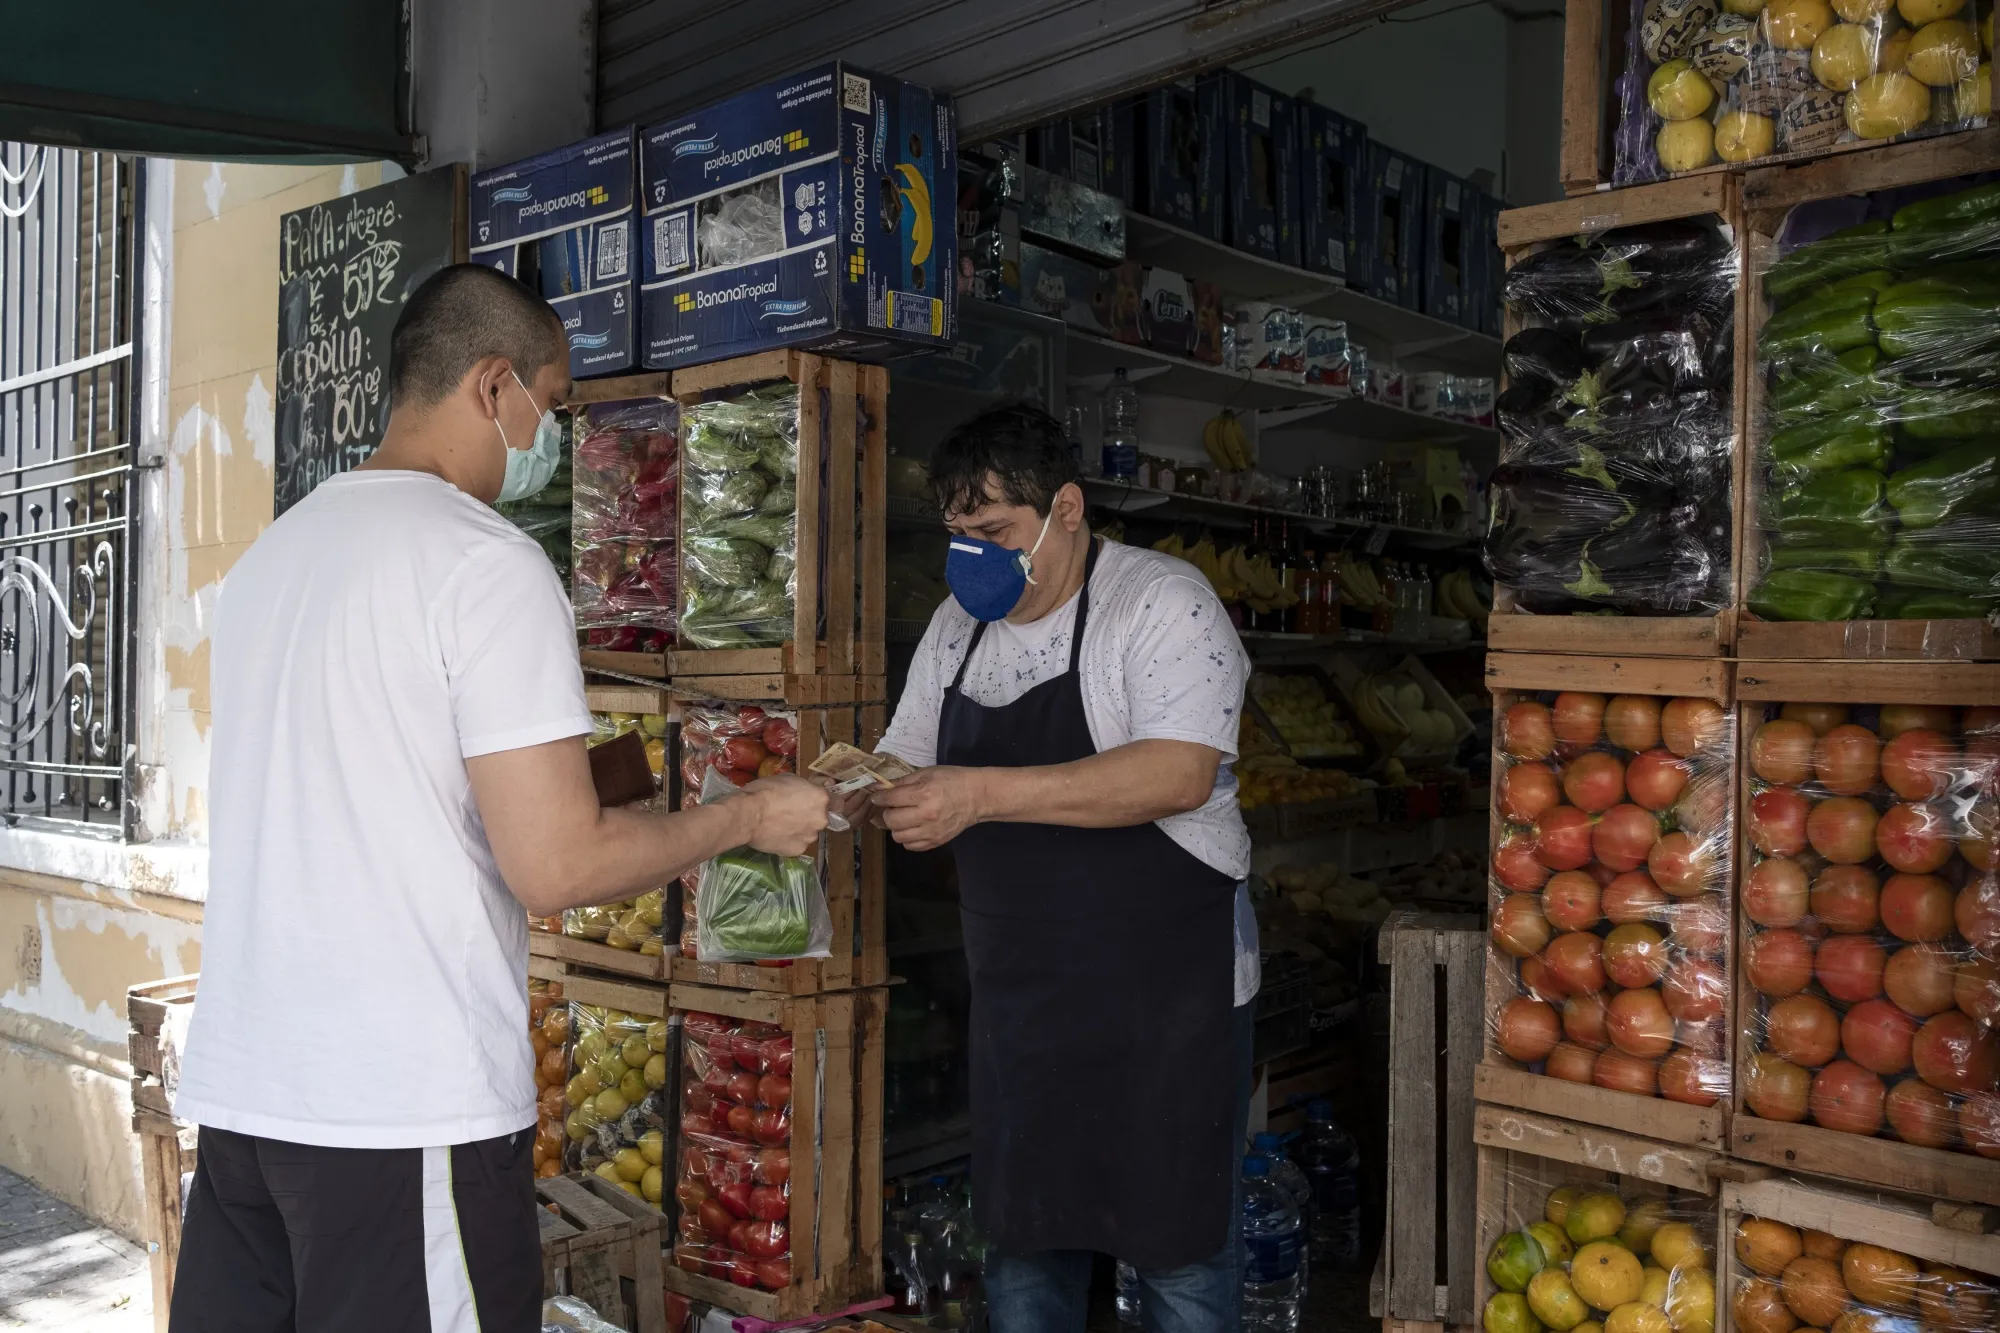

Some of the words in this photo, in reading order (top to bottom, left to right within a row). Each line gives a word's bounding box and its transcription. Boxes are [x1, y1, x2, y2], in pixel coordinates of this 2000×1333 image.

[876, 98, 886, 137] PREMIUM
[675, 142, 698, 156] PREMIUM
[704, 135, 782, 178] BananaTropical
[876, 138, 884, 164] EXTRA
[1726, 158, 1767, 170] Productos
[1769, 156, 1780, 164] de
[818, 181, 825, 192] U
[851, 123, 868, 244] BananaTropical
[518, 190, 586, 224] BananaTropical
[818, 195, 826, 206] X
[818, 209, 826, 228] 22
[697, 274, 777, 308] BananaTropical
[766, 303, 782, 312] EXTRA
[782, 301, 808, 312] PREMIUM
[806, 317, 828, 329] Aplicado
